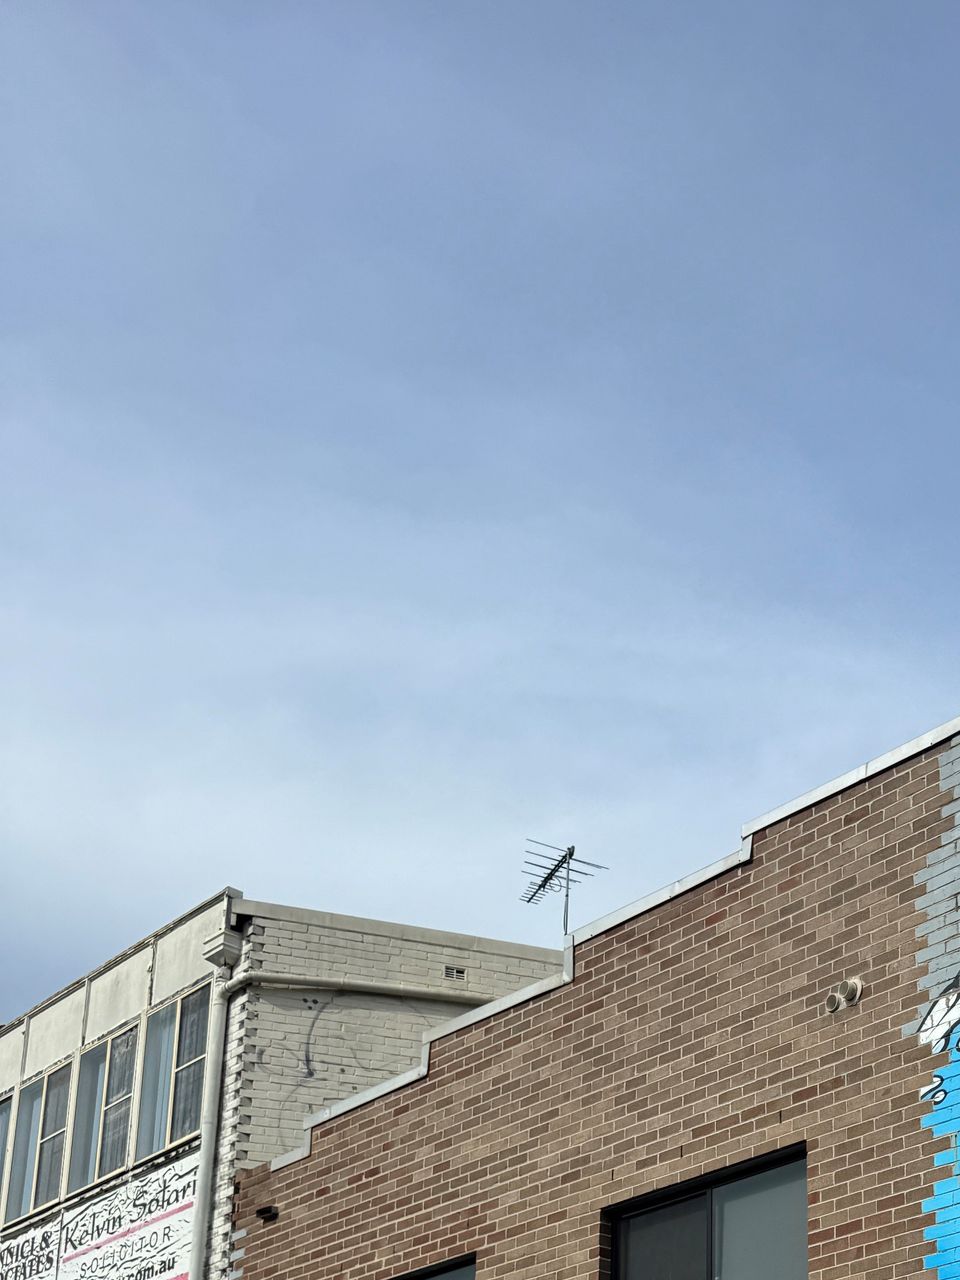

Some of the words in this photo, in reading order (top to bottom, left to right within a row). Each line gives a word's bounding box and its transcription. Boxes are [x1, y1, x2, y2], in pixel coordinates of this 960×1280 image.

[40, 1231, 52, 1252] &
[64, 1212, 125, 1254] Kelvin
[80, 1225, 172, 1279] SOLICITOR
